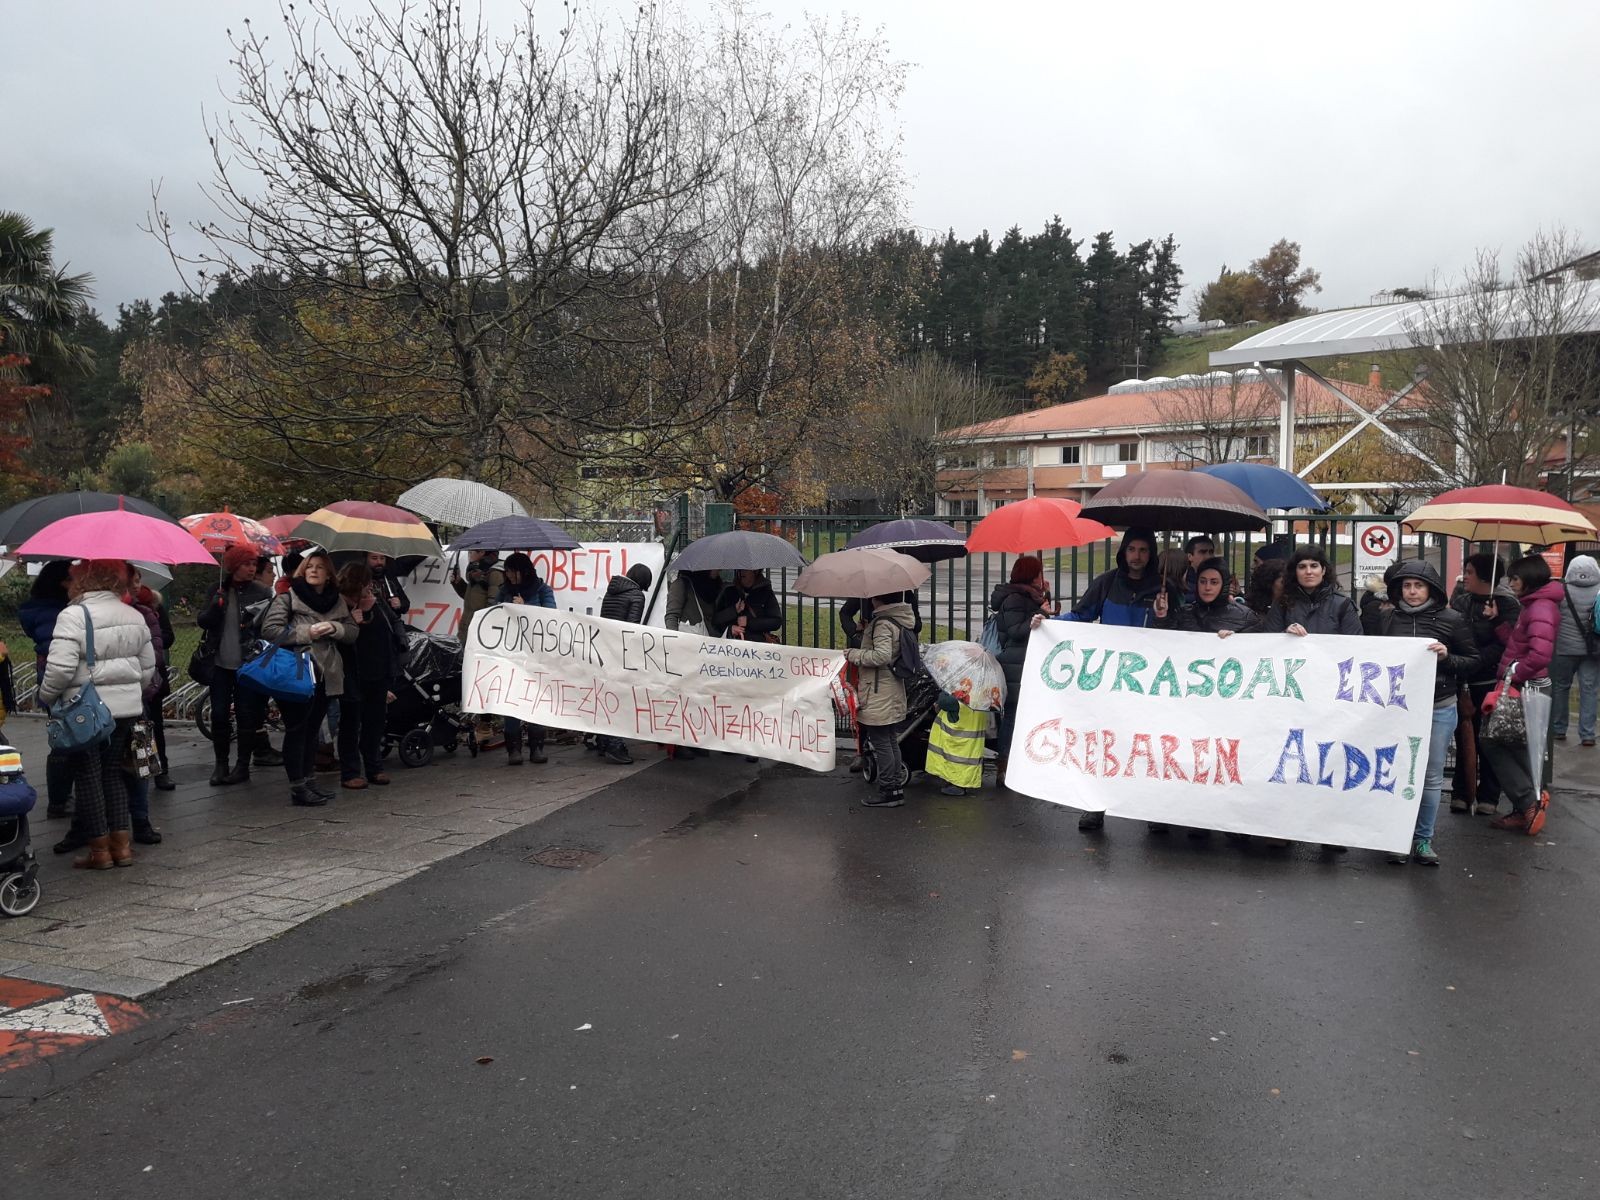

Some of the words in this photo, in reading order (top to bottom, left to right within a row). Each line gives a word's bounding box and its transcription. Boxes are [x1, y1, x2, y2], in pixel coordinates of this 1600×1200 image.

[526, 548, 628, 592] OBETU
[477, 606, 604, 667] GURASOAK
[621, 630, 683, 676] ERE
[699, 642, 761, 661] AZAROAK
[764, 651, 781, 661] 30
[700, 662, 766, 678] ABENDUAK
[769, 667, 788, 679] 12
[1040, 640, 1306, 701] GURASOAK
[1335, 657, 1409, 711] ERE
[467, 660, 619, 725] KALITATEZKO
[632, 686, 785, 747] HEZKUNTZAREN
[789, 709, 830, 753] ALDE
[1024, 718, 1243, 786] GREBAREN
[1268, 728, 1423, 800] ALDE!
